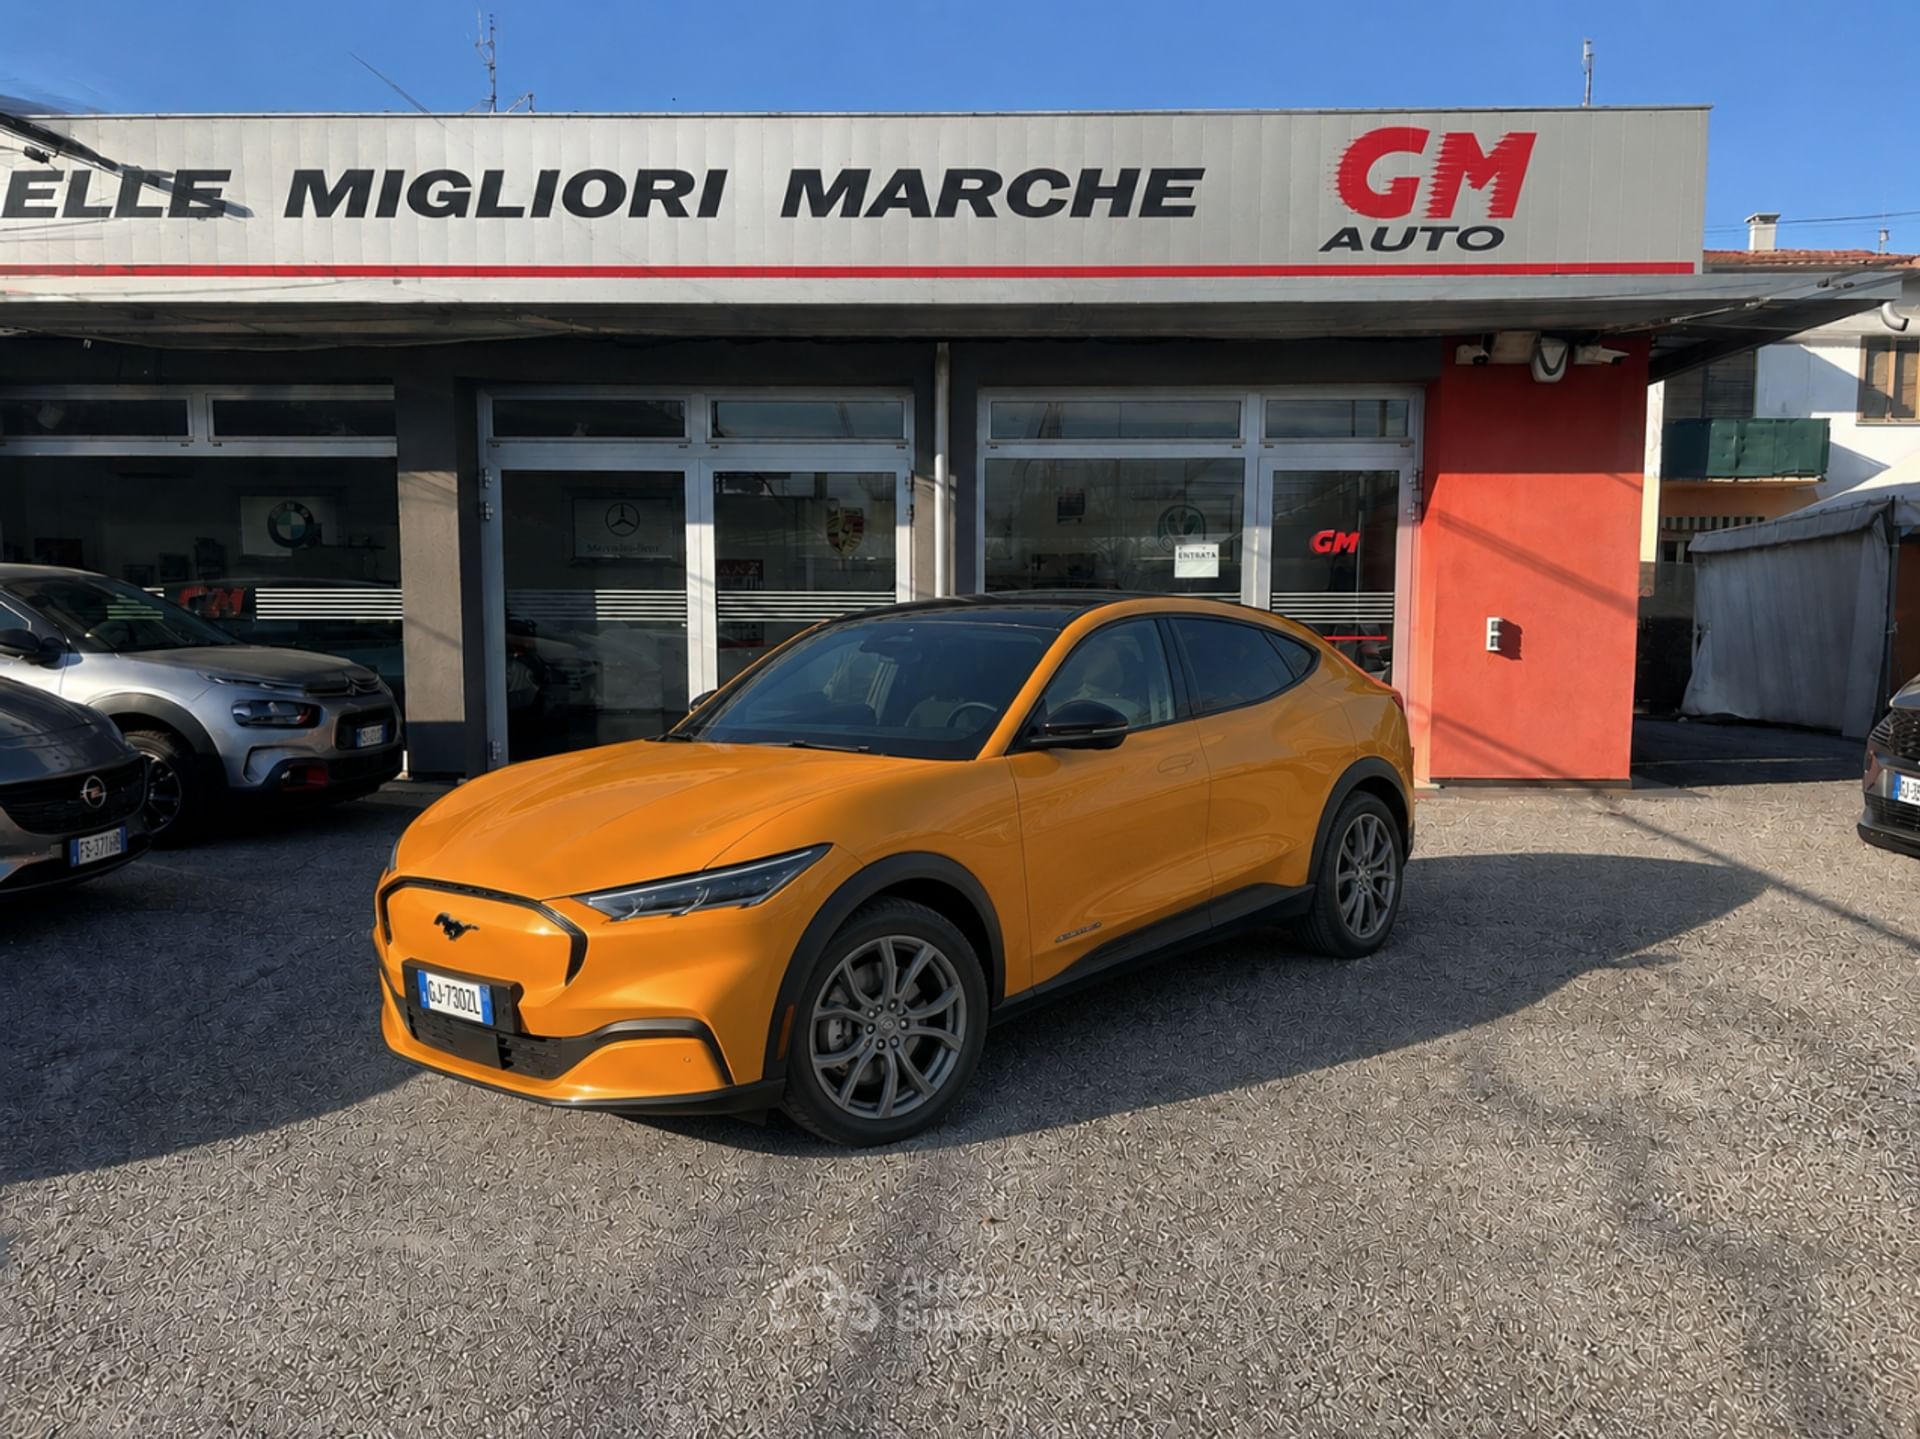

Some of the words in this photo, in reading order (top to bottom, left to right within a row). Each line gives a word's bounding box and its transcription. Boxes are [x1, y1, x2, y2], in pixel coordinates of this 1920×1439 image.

[1335, 126, 1538, 219] GM
[2, 169, 232, 218] ELLE
[284, 168, 729, 219] MIGLIORI
[780, 168, 1206, 219] MARCHE
[1318, 225, 1505, 252] AUTO
[1311, 529, 1360, 553] GM
[1178, 551, 1217, 560] ENTRATA
